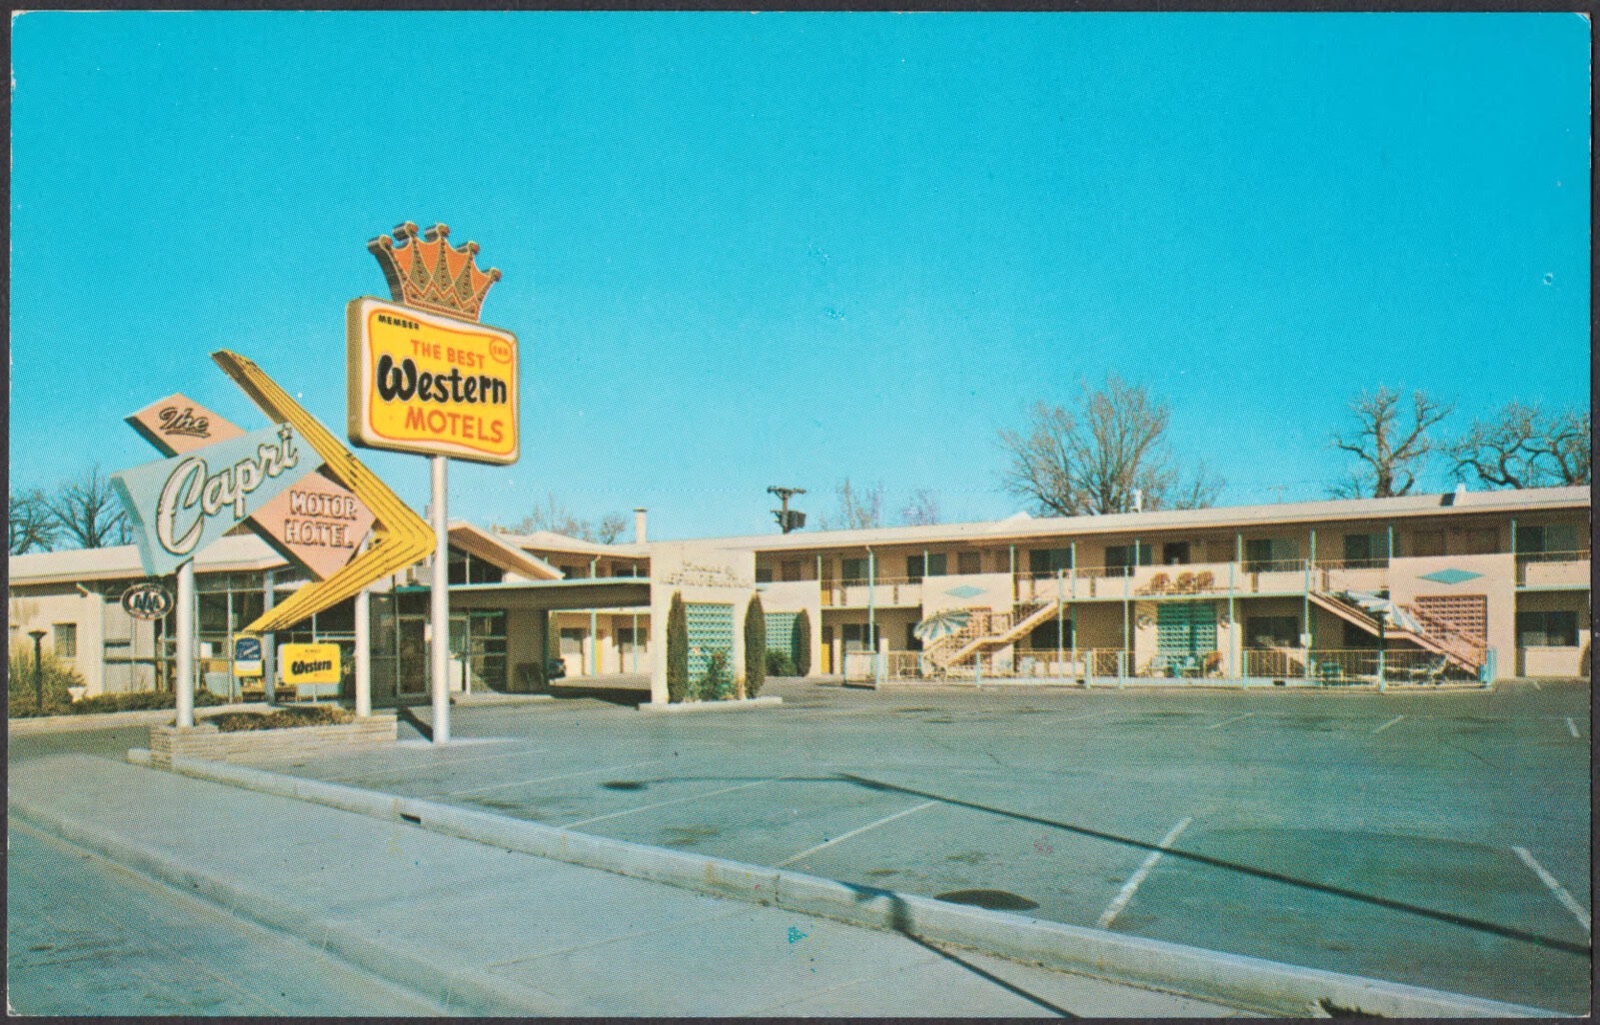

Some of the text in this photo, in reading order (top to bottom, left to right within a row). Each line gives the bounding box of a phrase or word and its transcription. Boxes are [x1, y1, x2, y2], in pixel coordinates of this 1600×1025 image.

[378, 314, 420, 331] MEMBER
[410, 339, 443, 361] THE
[446, 347, 486, 370] BEST
[376, 354, 507, 404] Western
[158, 406, 211, 438] The
[404, 406, 504, 444] MOTELS
[156, 423, 299, 556] Capri
[290, 490, 358, 521] MOTOR
[284, 519, 354, 549] HOTEL
[291, 659, 333, 675] Western
